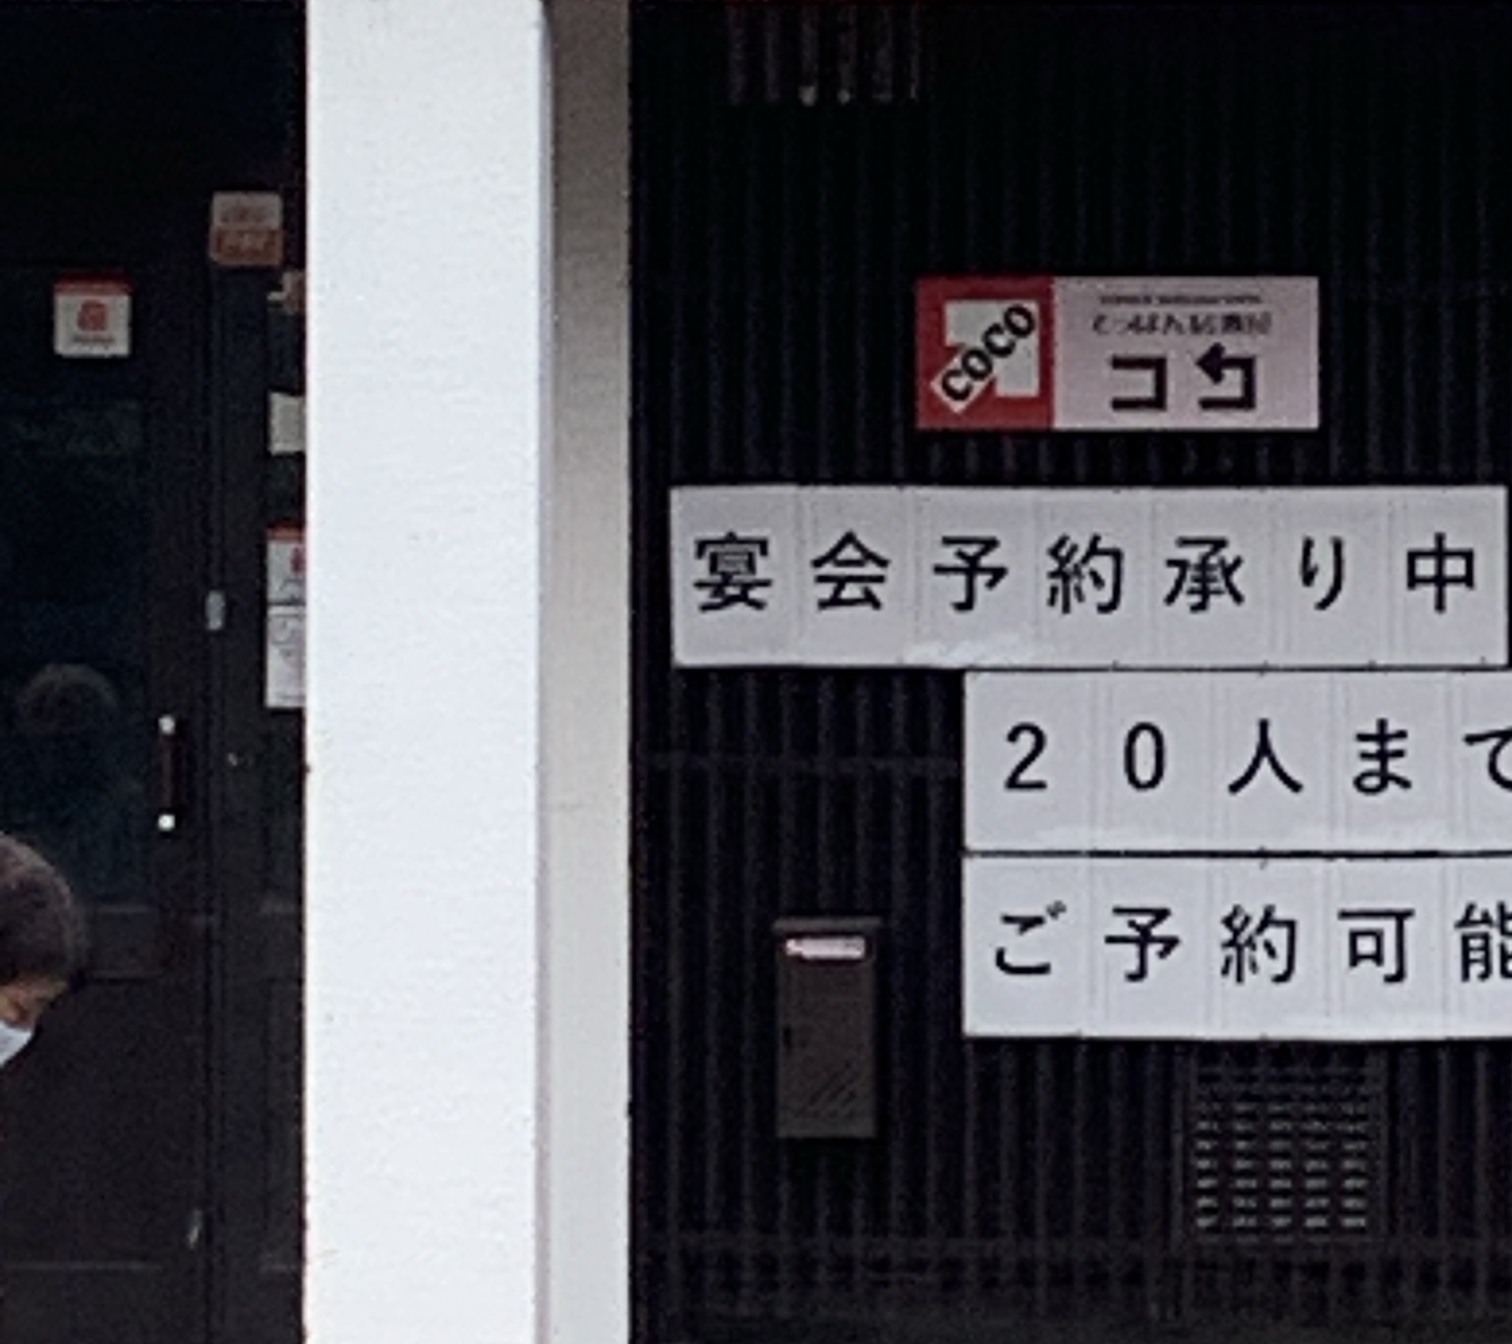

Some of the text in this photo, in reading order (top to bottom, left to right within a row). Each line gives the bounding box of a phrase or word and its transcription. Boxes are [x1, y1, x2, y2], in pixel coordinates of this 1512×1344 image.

[940, 304, 1036, 402] COCO
[693, 531, 1477, 614] 宴会予約承り中
